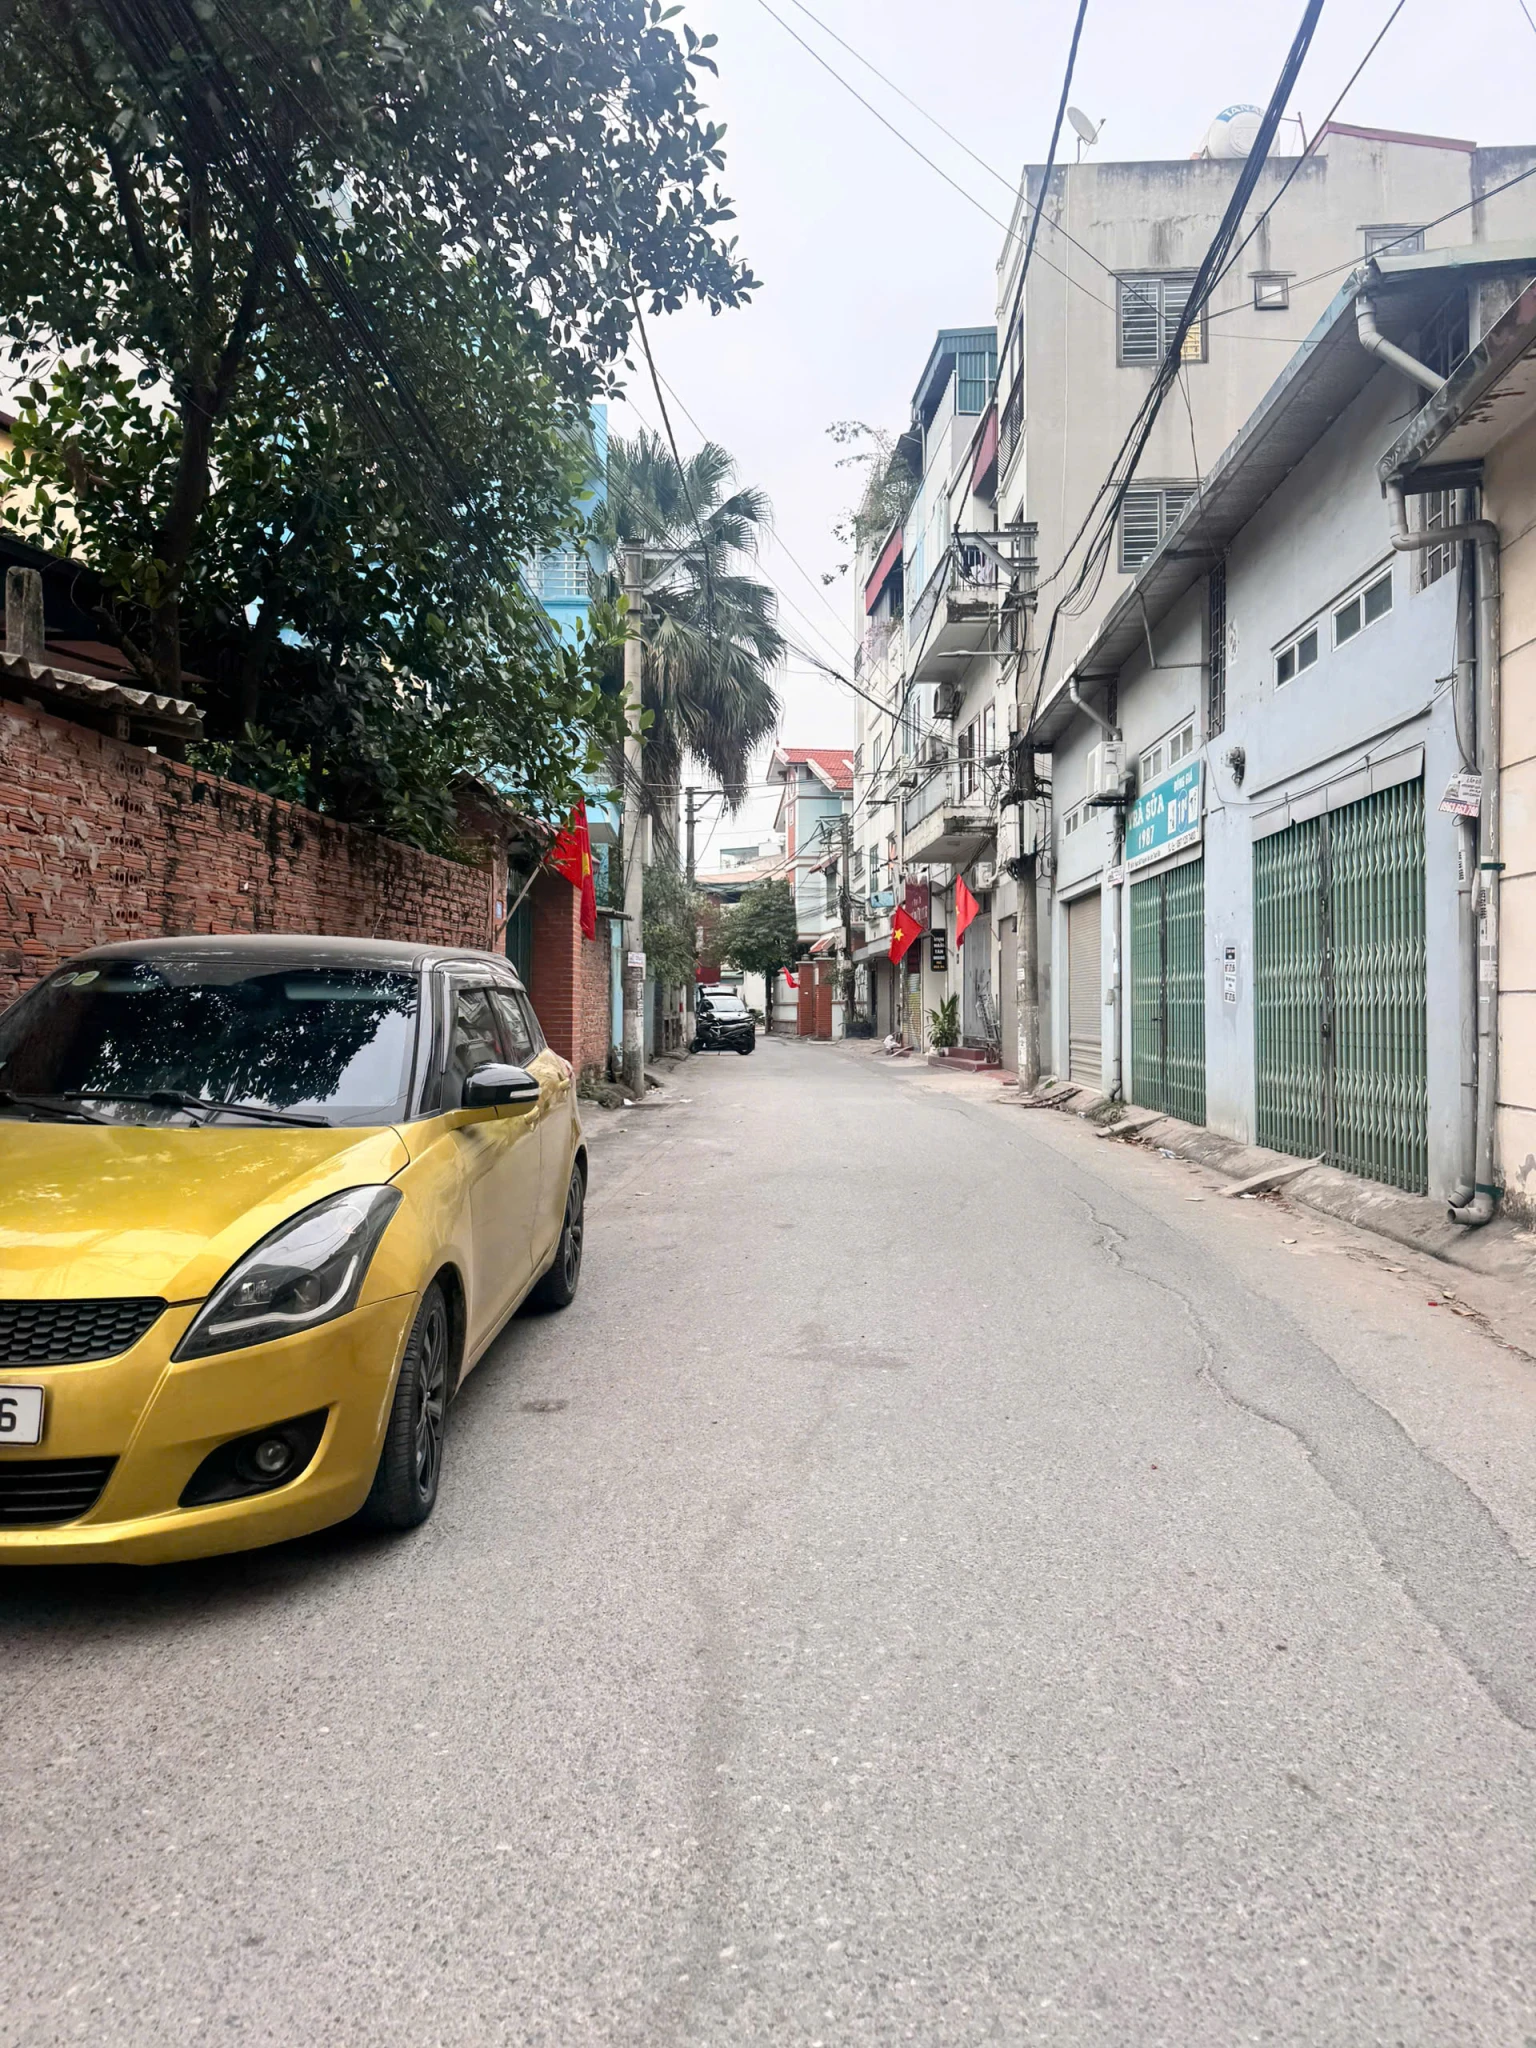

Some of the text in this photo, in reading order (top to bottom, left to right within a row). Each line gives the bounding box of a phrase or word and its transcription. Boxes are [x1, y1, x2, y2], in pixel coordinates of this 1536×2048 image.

[1128, 792, 1165, 830] TRÀ SỮA
[1138, 825, 1155, 850] 1987
[0, 1397, 18, 1433] 6
